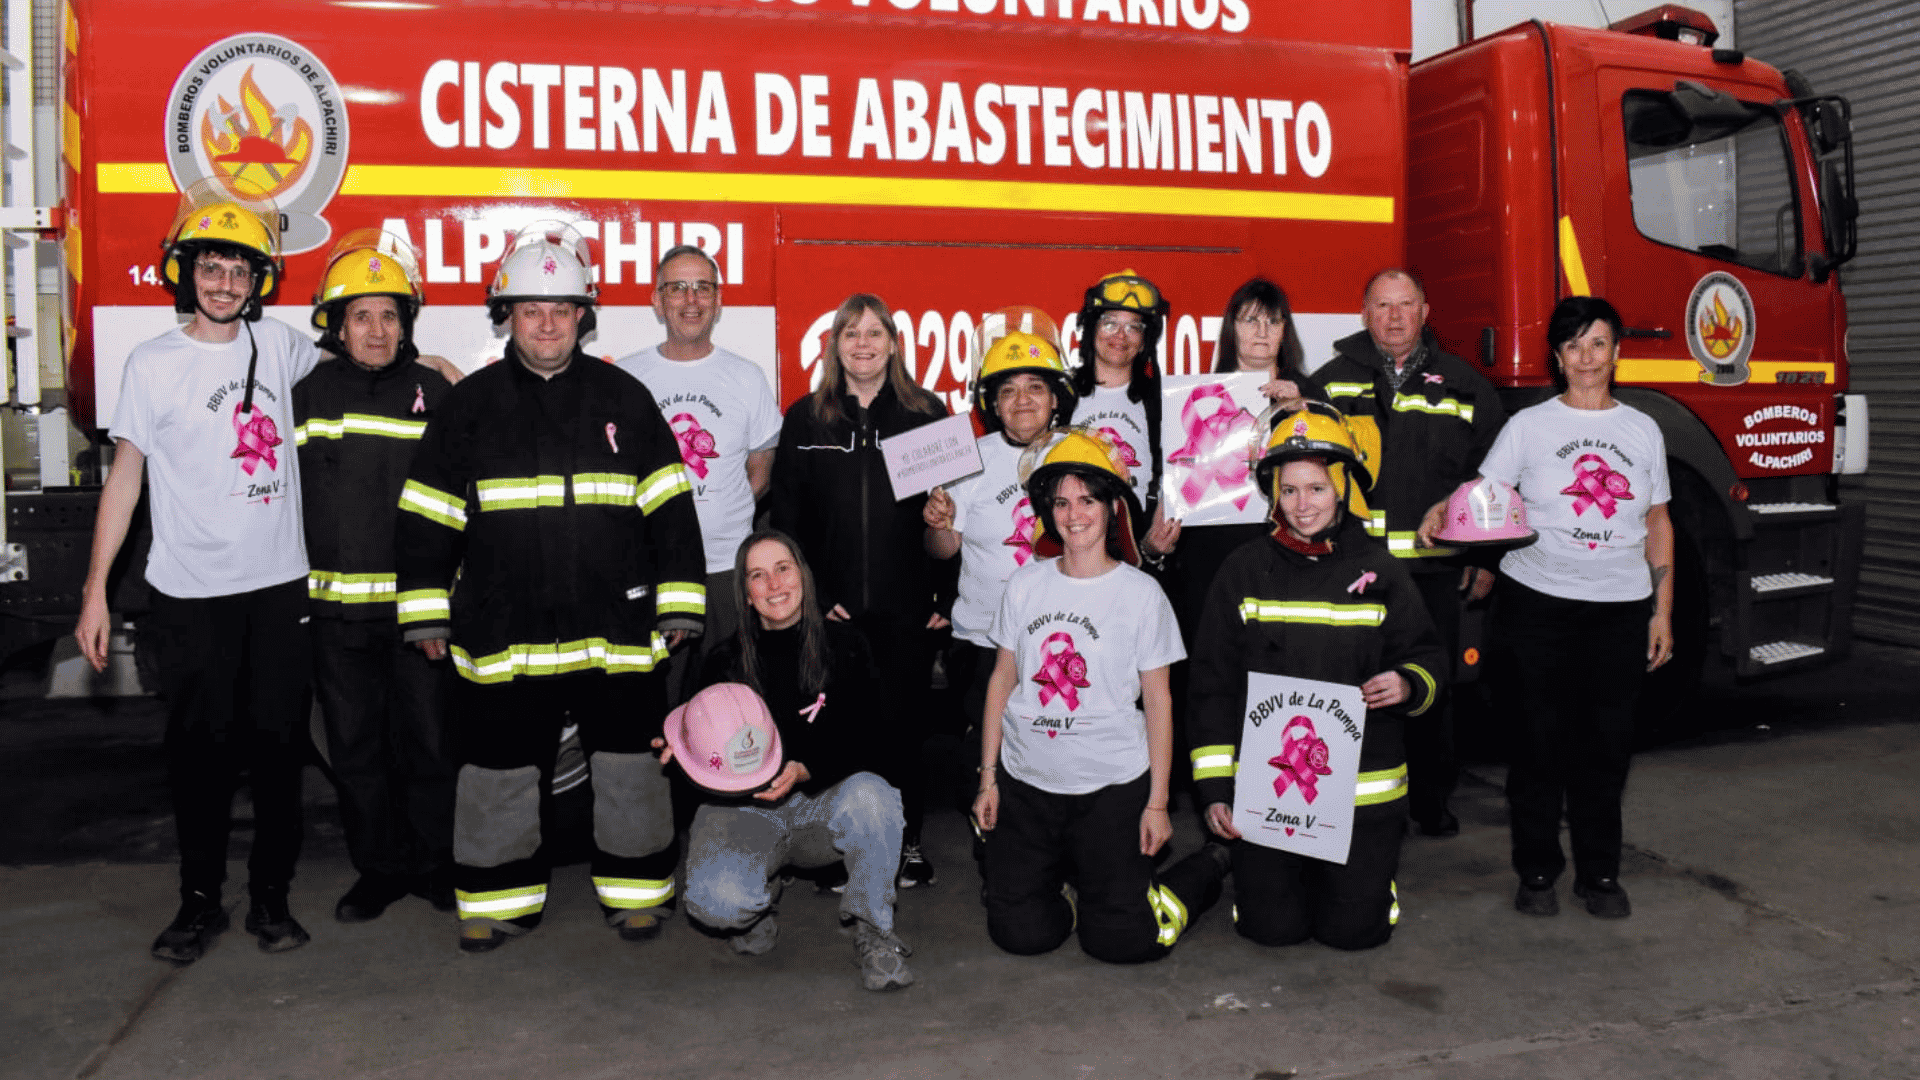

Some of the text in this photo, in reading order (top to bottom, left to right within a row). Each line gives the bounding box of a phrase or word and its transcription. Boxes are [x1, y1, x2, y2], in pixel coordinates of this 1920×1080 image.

[177, 43, 338, 156] BOMBEROS VOLUNTARIOS DE ALPACHIRI
[420, 59, 1332, 178] CISTERNA DE ABASTECIMIENTO
[207, 385, 228, 412] BBVV
[1744, 405, 1818, 429] BOMBEROS
[1556, 440, 1579, 459] BBVV
[1582, 438, 1593, 447] de
[1595, 439, 1607, 449] La
[1735, 430, 1826, 447] VOLUNTARIOS
[1749, 447, 1813, 469] ALPACHIRI
[248, 479, 280, 498] Zona V
[996, 483, 1018, 504] BBVV
[1572, 527, 1613, 542] Zona V
[1027, 613, 1051, 635] BBVV
[1054, 610, 1066, 621] de
[1067, 612, 1080, 624] La
[1032, 715, 1075, 730] Zona V
[1249, 691, 1362, 742] BBVV de La Pampa
[1265, 807, 1317, 829] Zona V
